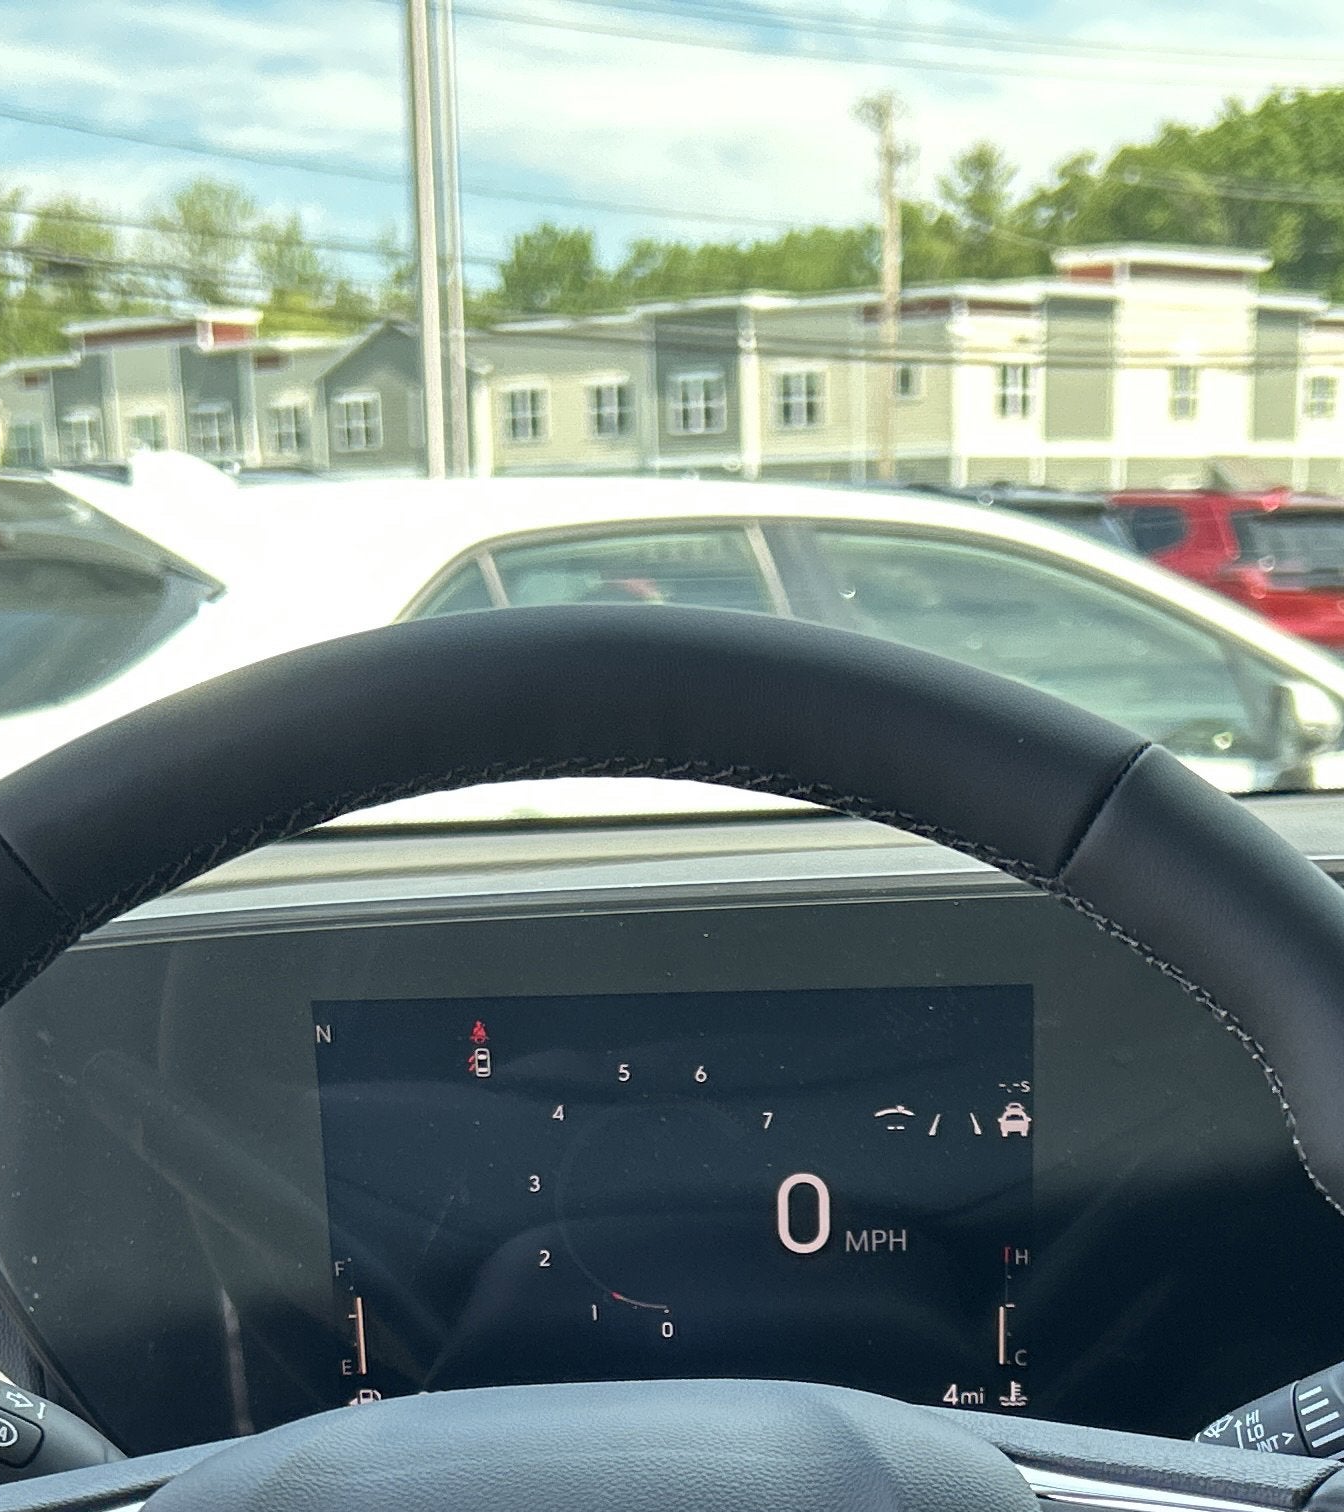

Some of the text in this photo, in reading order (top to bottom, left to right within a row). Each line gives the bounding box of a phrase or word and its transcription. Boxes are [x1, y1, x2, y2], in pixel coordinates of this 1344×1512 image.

[315, 1024, 331, 1043] N
[618, 1063, 631, 1082] 5
[694, 1065, 708, 1083] 6
[552, 1104, 565, 1121] 4
[762, 1111, 773, 1129] 7
[529, 1174, 541, 1193] 3
[777, 1173, 907, 1254] 0 MPH
[539, 1249, 551, 1267] 2
[1015, 1249, 1029, 1265] H
[334, 1261, 345, 1277] F
[591, 1304, 598, 1321] 1
[661, 1321, 674, 1338] 0
[1014, 1349, 1027, 1366] C
[341, 1359, 352, 1376] E
[1246, 1409, 1259, 1427] HI
[1246, 1424, 1265, 1442] LO
